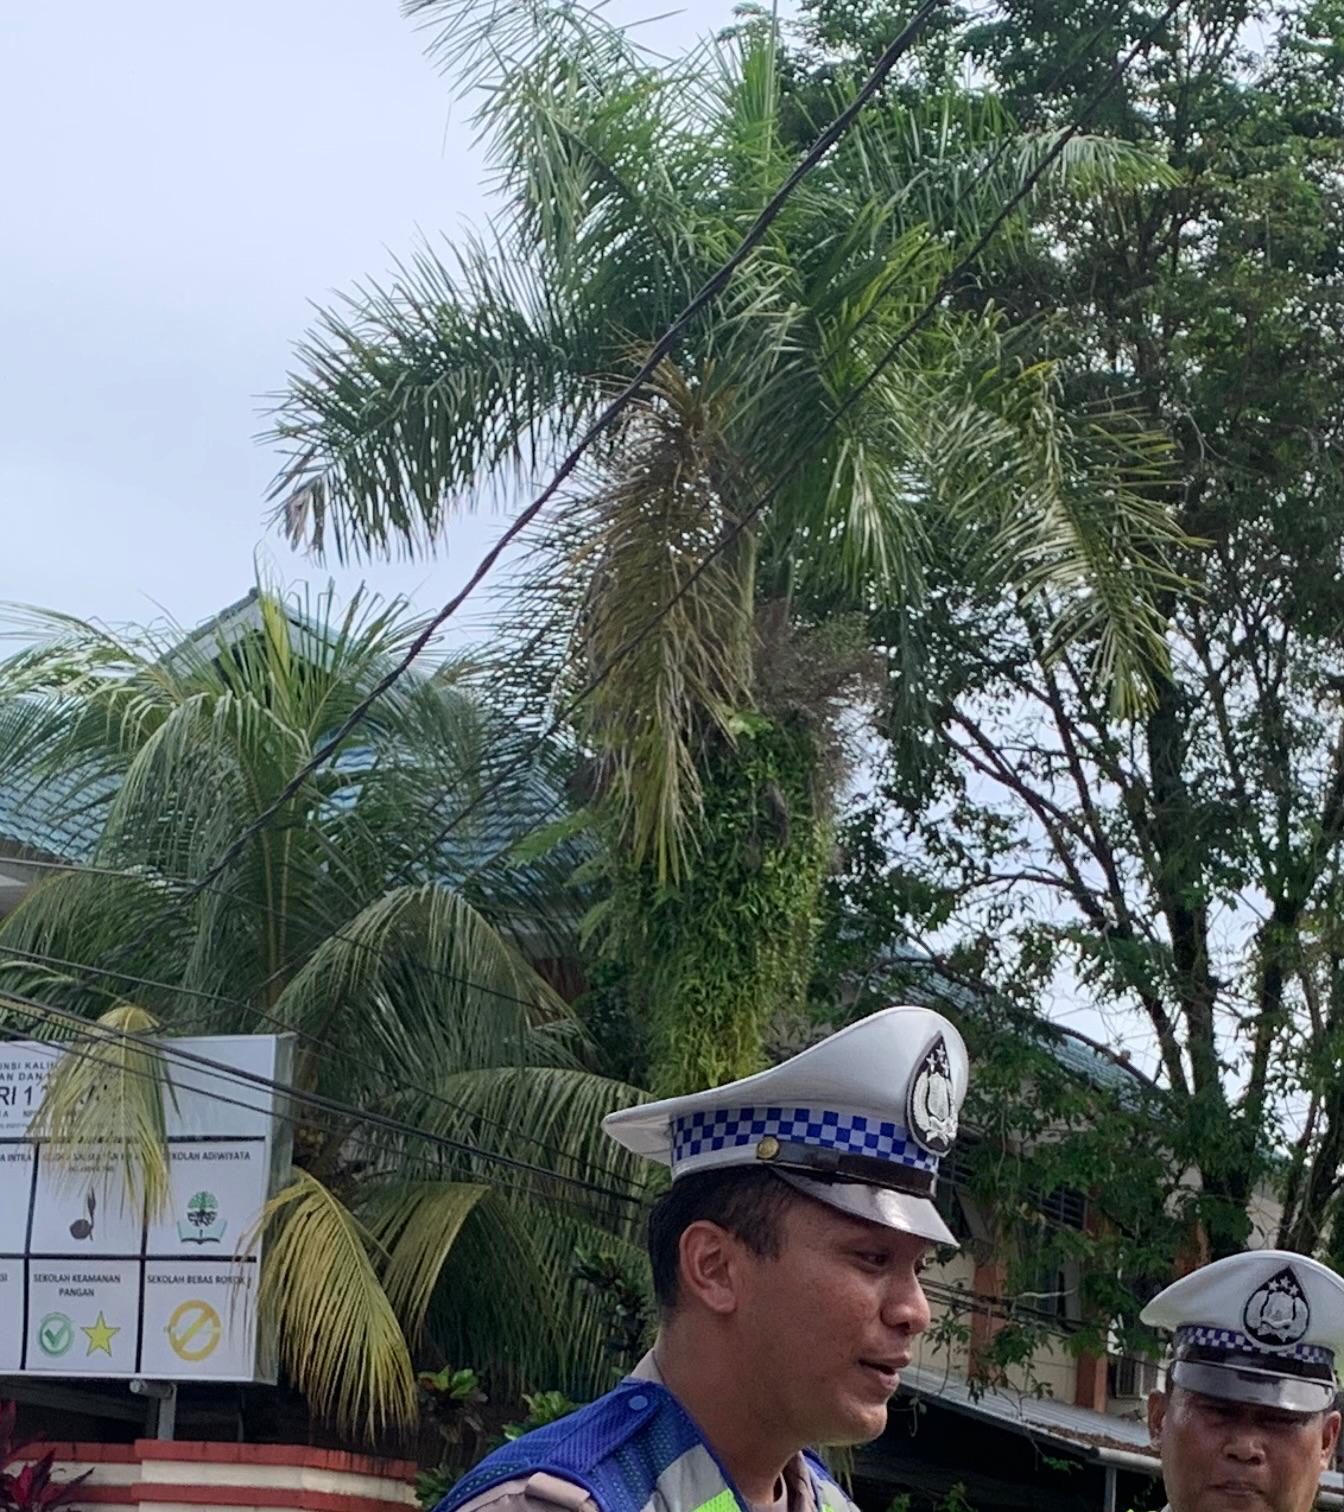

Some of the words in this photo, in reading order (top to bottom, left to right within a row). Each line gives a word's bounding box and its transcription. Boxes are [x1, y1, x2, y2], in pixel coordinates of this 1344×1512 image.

[18, 1072, 43, 1081] DAN
[23, 1086, 33, 1106] 1
[7, 1153, 32, 1162] INTRA
[203, 1151, 251, 1161] ADIWIYATA
[33, 1273, 71, 1283] SEKOLAH
[72, 1274, 121, 1283] KEAMANAN
[147, 1275, 185, 1284] SEKOLAH
[186, 1274, 213, 1284] BEBAS
[58, 1288, 95, 1297] PANGAN
